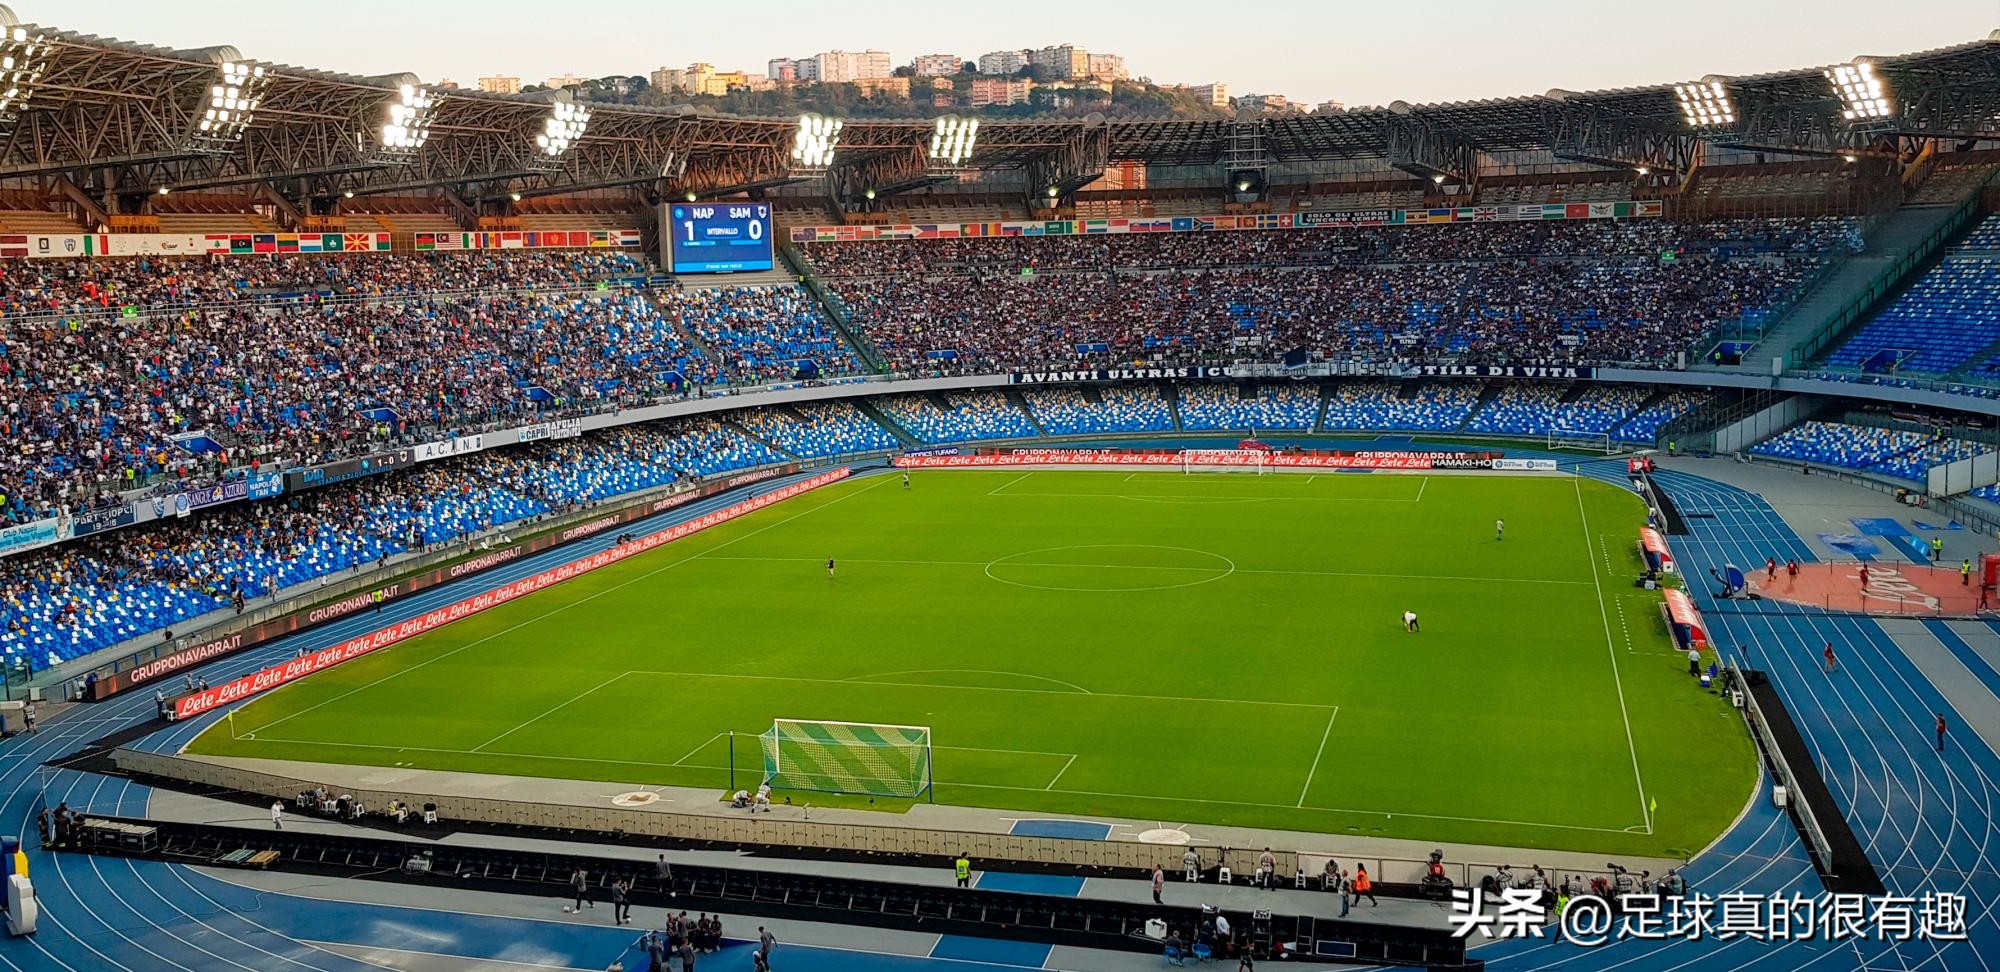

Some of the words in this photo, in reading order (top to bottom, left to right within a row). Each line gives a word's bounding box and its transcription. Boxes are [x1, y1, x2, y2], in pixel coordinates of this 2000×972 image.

[693, 208, 715, 219] NAP
[729, 207, 751, 218] SAM
[684, 221, 694, 241] 1
[748, 220, 762, 240] 0
[1021, 370, 1099, 383] AVANTI
[1108, 368, 1188, 379] ULTRAS
[1489, 367, 1514, 376] DI
[1523, 367, 1578, 378] VITA
[551, 418, 580, 430] APULIA
[526, 427, 549, 440] CAPRI
[935, 448, 958, 456] TUFANO
[897, 456, 920, 466] Lete
[921, 456, 944, 466] Lete
[947, 456, 970, 465] Lete
[971, 456, 995, 464] Lete
[997, 455, 1019, 464] Lete
[1021, 455, 1044, 463] Lete
[1047, 454, 1069, 463] Lete
[1071, 454, 1093, 463] Lete
[1095, 454, 1118, 463] Lete
[1119, 455, 1143, 463] Lete
[1144, 455, 1168, 463] Lete
[1195, 455, 1219, 464] Lete
[1221, 456, 1245, 464] Lete
[1271, 456, 1296, 465] Lete
[1298, 456, 1322, 465] Lete
[1324, 457, 1348, 466] Lete
[1350, 458, 1376, 466] Lete
[1376, 458, 1402, 467] Lete
[1404, 458, 1430, 468] Lete
[1432, 459, 1491, 467] HAMAKI-HO
[729, 468, 780, 487] GRUPPONAVARRA.IT
[187, 488, 212, 507] SANGUE
[225, 481, 247, 498] AZZURRO
[654, 489, 700, 511] GRUPPONAVARRA.IT
[563, 515, 620, 540] GRUPPONAVARRA.IT
[610, 546, 626, 561] Lete
[626, 540, 642, 555] Lete
[450, 546, 522, 576] GRUPPONAVARRA.IT
[574, 559, 592, 574] Lete
[592, 552, 609, 568] Lete
[536, 572, 555, 588] Lete
[555, 565, 574, 581] Lete
[493, 587, 514, 603] Lete
[514, 579, 534, 595] Lete
[448, 602, 470, 620] Lete
[471, 594, 492, 611] Lete
[423, 611, 447, 628] Lete
[398, 619, 422, 638] Lete
[371, 629, 396, 648] Lete
[344, 638, 370, 658] Lete
[131, 635, 242, 682] GRUPPONAVARRA.IT
[314, 648, 342, 668] Lete
[282, 658, 312, 679] Lete
[250, 670, 281, 691] Lete
[216, 680, 249, 703] Lete
[179, 693, 214, 716] Lete
